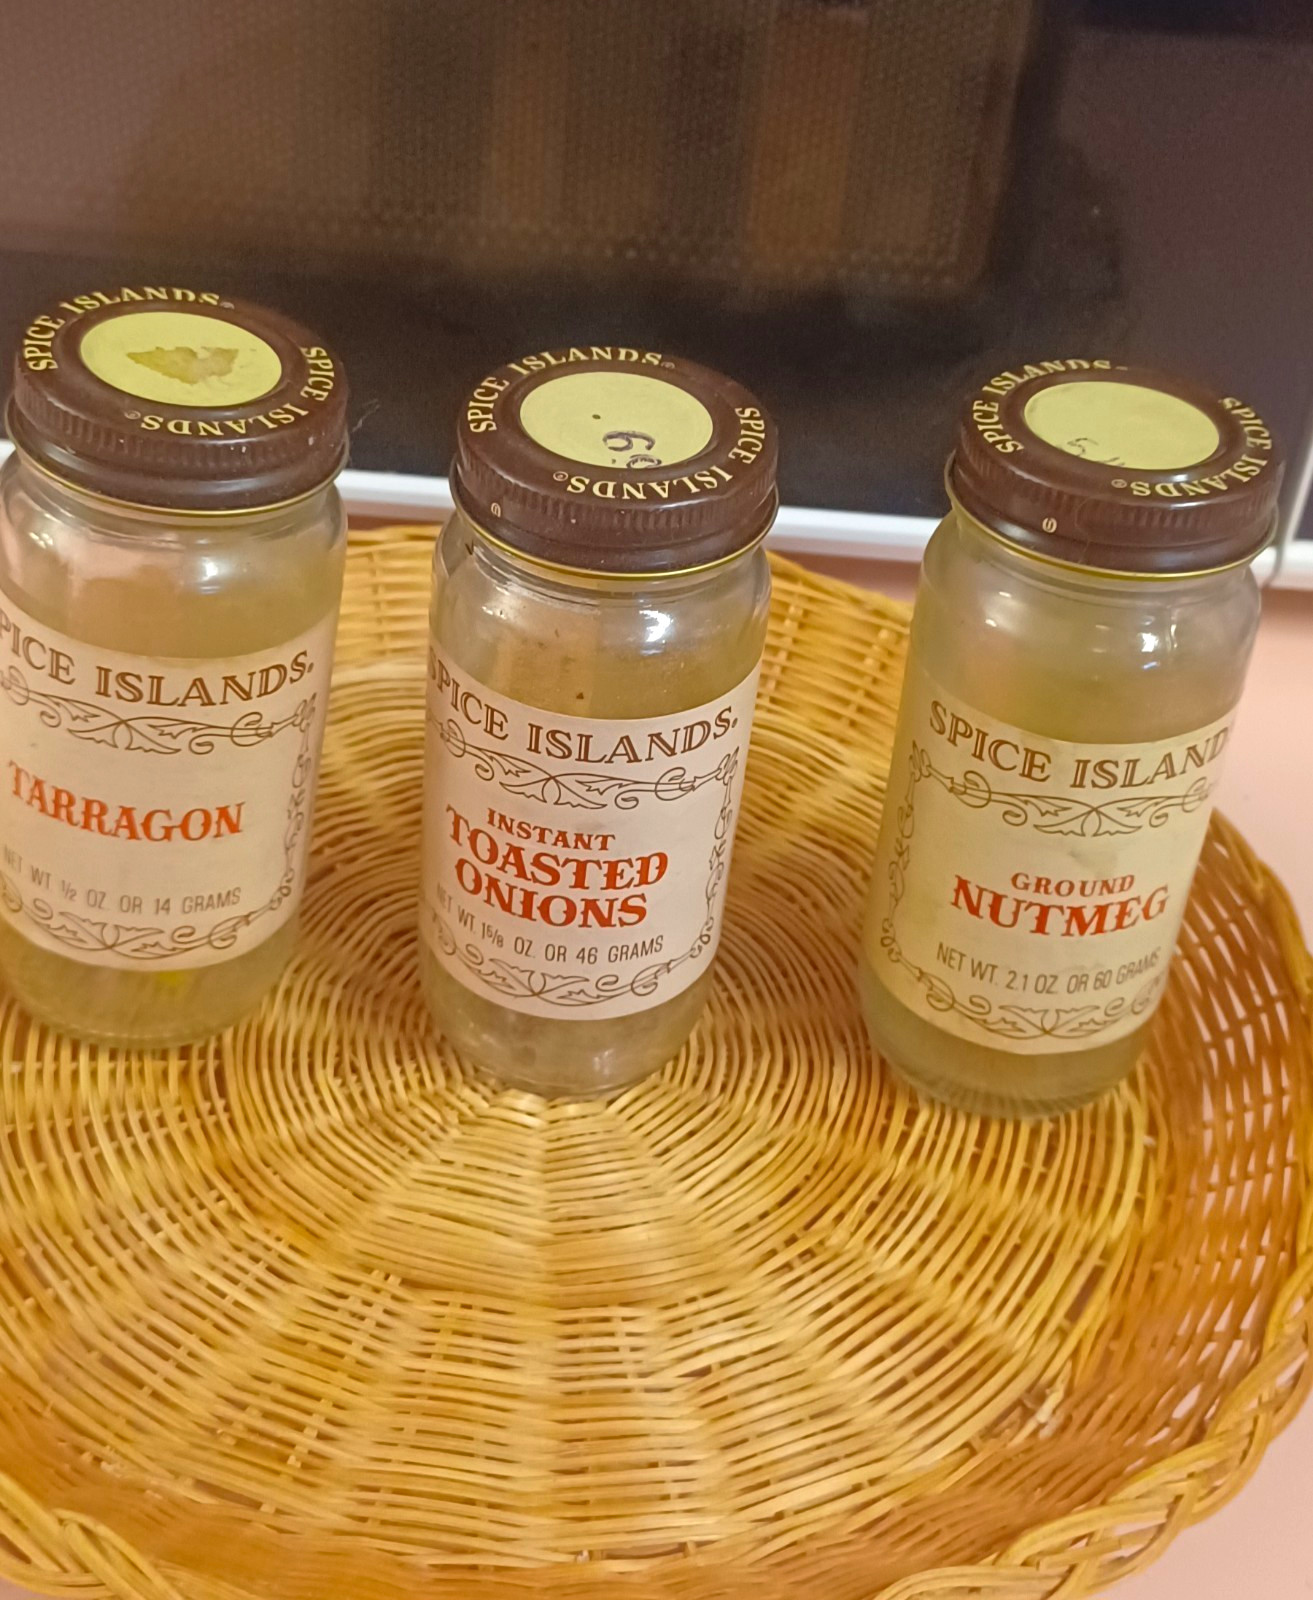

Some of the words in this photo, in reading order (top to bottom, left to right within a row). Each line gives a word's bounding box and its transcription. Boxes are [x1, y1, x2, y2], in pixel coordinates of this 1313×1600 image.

[24, 316, 65, 371] SPICE
[300, 347, 335, 401] SPICE
[467, 377, 510, 432] SPICE
[508, 346, 662, 375] ISLANDS
[728, 407, 765, 464] SPICE
[972, 400, 1024, 453] SPICE
[1220, 397, 1272, 450] SPICE
[0, 608, 76, 685] PICE
[929, 700, 1051, 782] SPICE
[1070, 726, 1229, 789] ISLAND
[8, 760, 246, 842] TARRAGON
[446, 804, 668, 891] TOASTED
[486, 808, 615, 851] INSTANT
[120, 895, 142, 914] OR
[154, 898, 171, 915] 14
[182, 887, 241, 914] GRAMS
[455, 858, 647, 928] ONIONS
[951, 875, 1168, 937] NUTMEG
[1010, 872, 1135, 898] GROUND
[545, 943, 567, 962] OR
[576, 947, 598, 965] 46
[608, 934, 664, 963] GRAMS
[936, 942, 967, 972] NET
[1066, 974, 1089, 994] OR
[1093, 969, 1113, 990] 60
